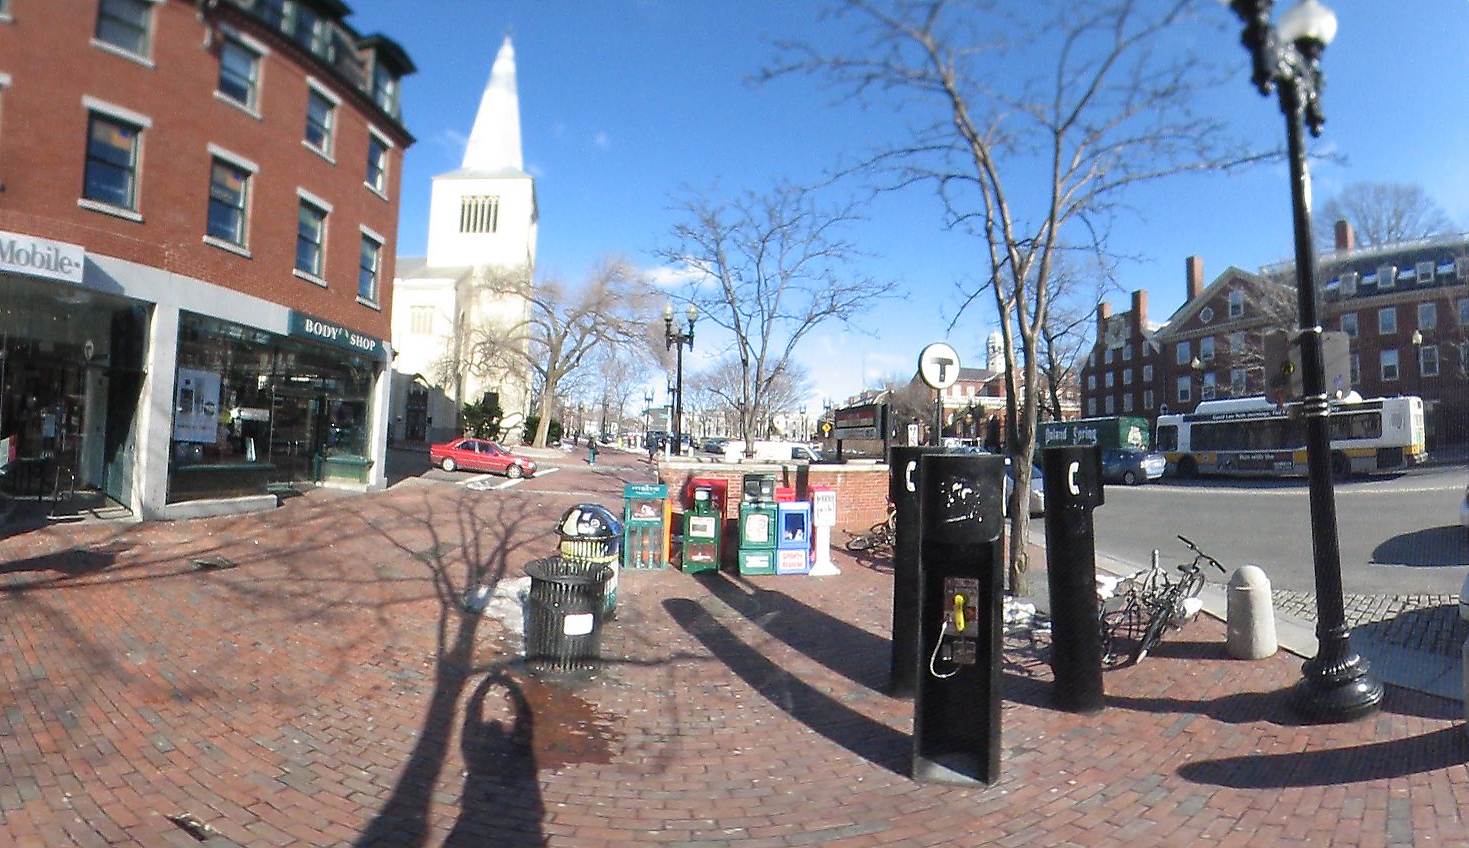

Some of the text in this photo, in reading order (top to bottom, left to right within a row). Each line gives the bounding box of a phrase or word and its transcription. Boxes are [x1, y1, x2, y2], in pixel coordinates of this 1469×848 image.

[305, 318, 376, 352] BODY SHOP
[930, 357, 954, 383] T
[1045, 426, 1098, 446] Poland Spring
